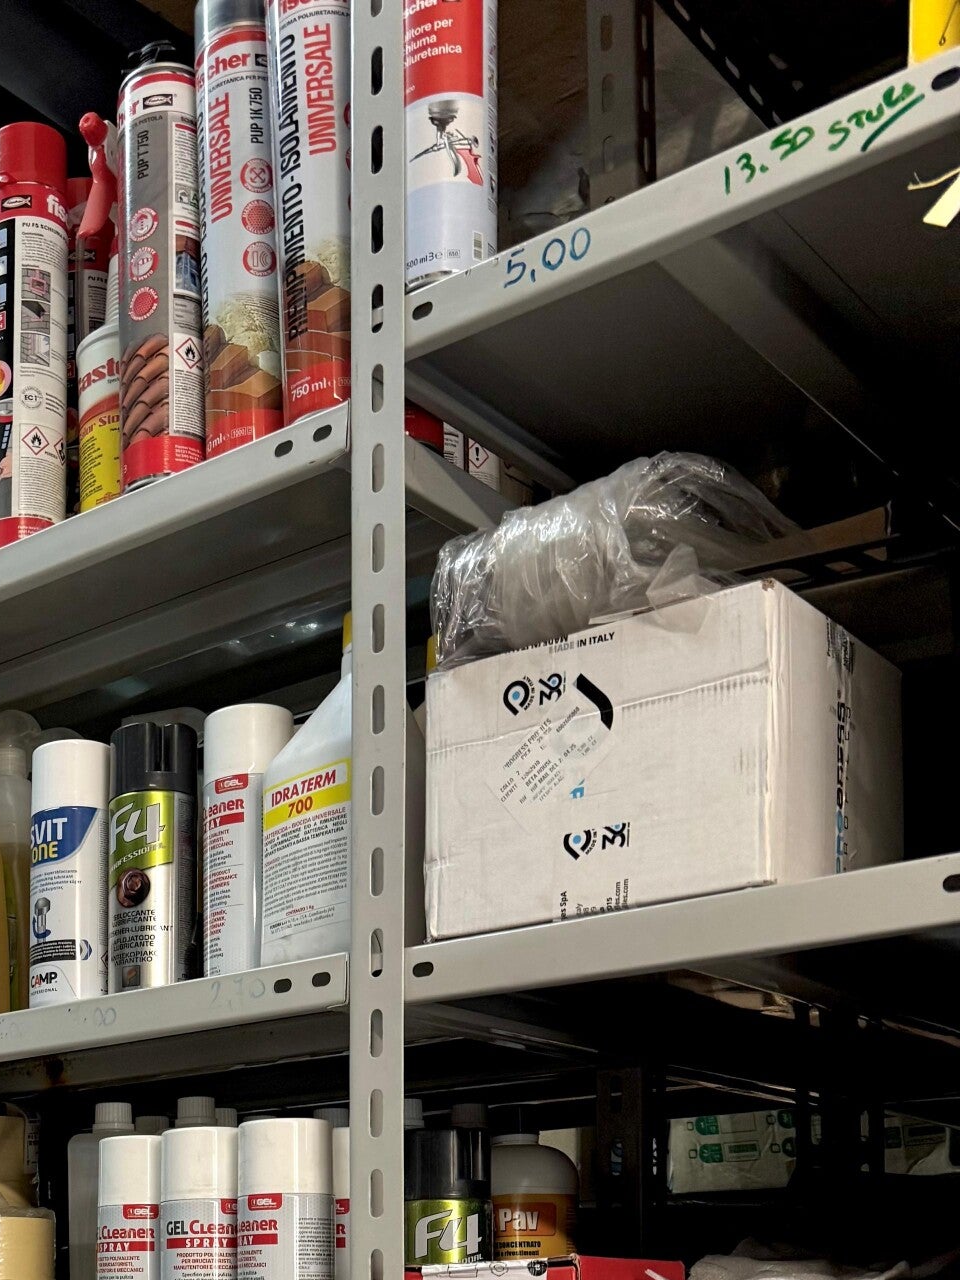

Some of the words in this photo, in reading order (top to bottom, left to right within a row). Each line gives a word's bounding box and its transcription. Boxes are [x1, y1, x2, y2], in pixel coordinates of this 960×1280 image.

[434, 18, 453, 33] per
[249, 87, 262, 108] 750
[303, 23, 337, 156] UNIVERSALE
[279, 34, 301, 179] ISOLAMENTO
[251, 123, 264, 144] PUP
[209, 92, 232, 224] UNIVERSALE
[503, 228, 592, 287] 5,00
[291, 383, 309, 402] 750
[311, 378, 326, 393] ml
[577, 638, 587, 647] IN
[589, 632, 615, 646] ITALY
[271, 770, 337, 807] IDRATERM
[288, 796, 314, 818] 700
[312, 807, 346, 822] UNIVERSALE
[30, 972, 58, 990] CAMP
[167, 1221, 188, 1235] GEL
[498, 1207, 540, 1233] Pav
[186, 1237, 228, 1248] SPRAY
[413, 1208, 483, 1260] F4
[99, 1241, 130, 1252] SPRAY
